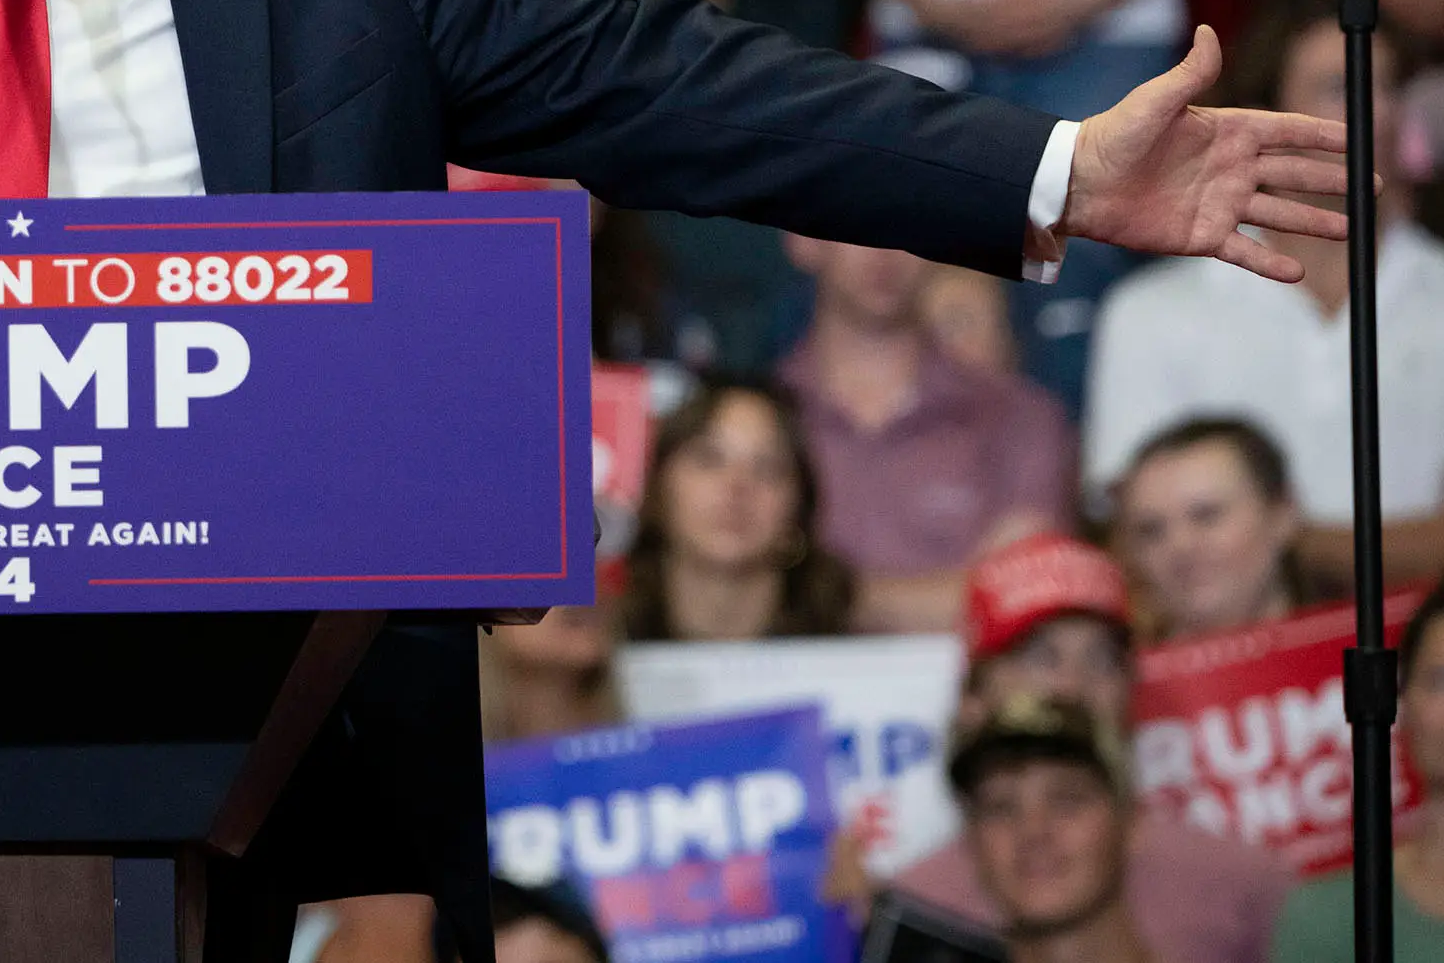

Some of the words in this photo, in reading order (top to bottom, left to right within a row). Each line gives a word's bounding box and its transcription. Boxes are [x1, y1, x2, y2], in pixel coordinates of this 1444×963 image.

[52, 257, 136, 304] TO
[156, 254, 349, 304] 88022
[87, 521, 209, 547] AGAIN!
[487, 772, 807, 886] RUMP
